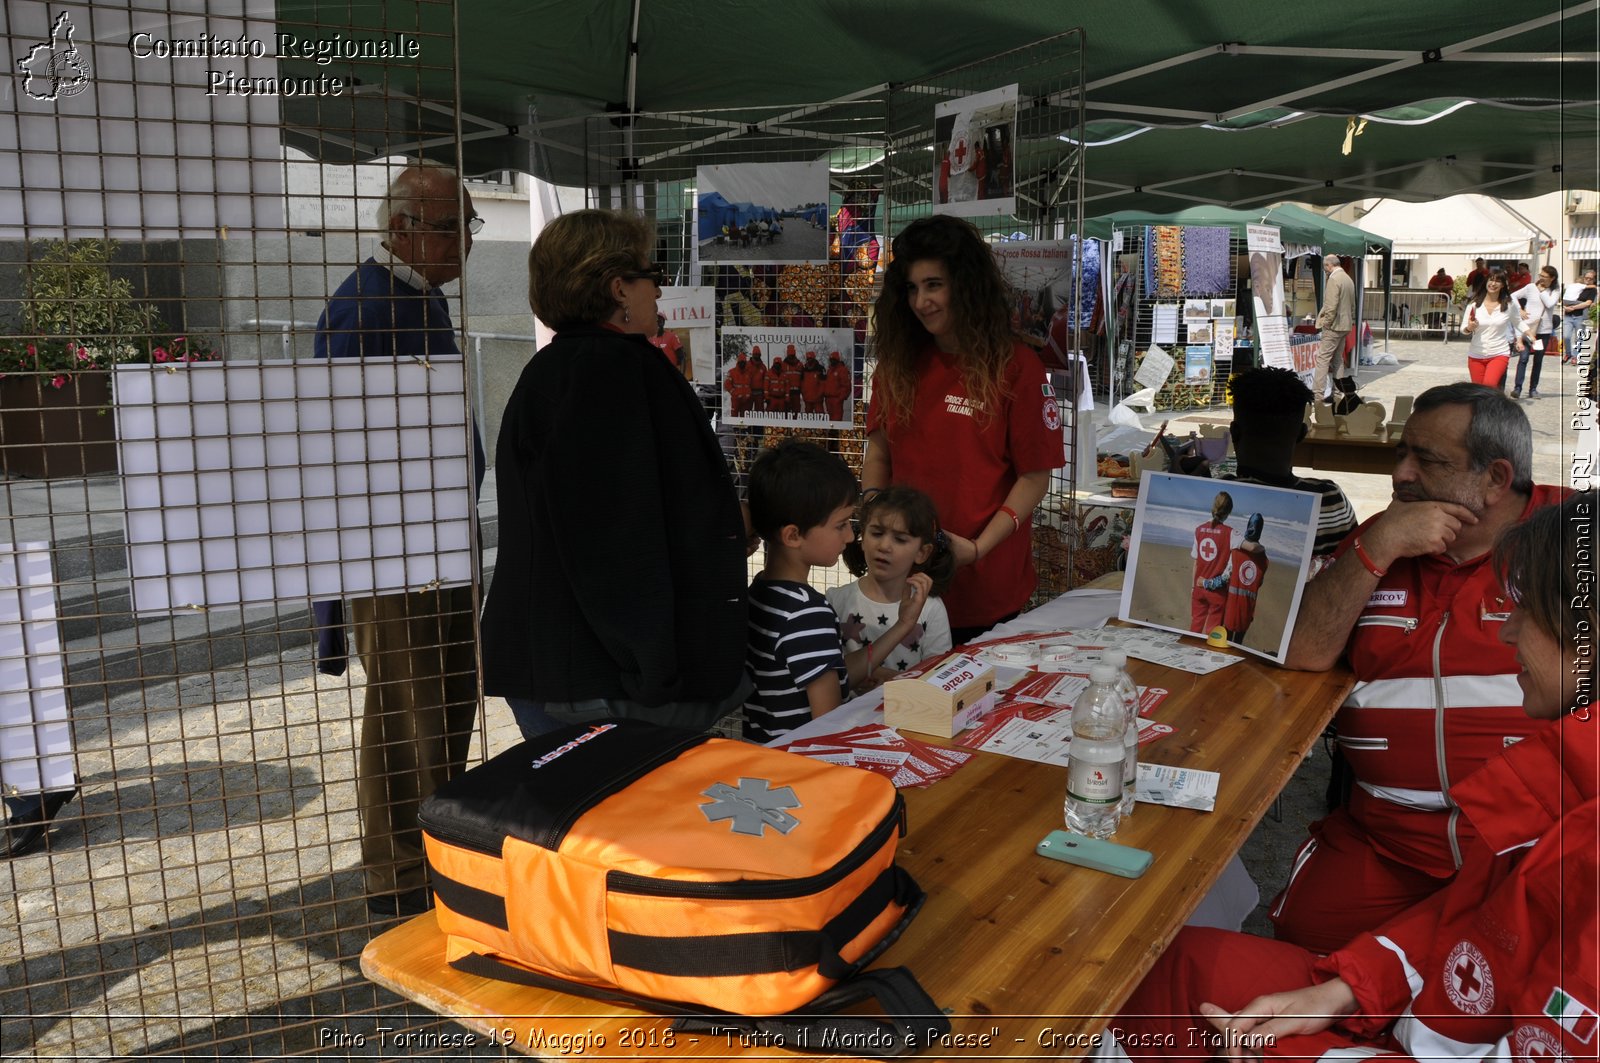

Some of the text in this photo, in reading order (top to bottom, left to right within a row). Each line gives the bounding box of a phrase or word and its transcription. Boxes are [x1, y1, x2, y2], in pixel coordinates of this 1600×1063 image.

[1002, 247, 1068, 259] Croce Rossa Italiana
[672, 306, 711, 320] ITAL
[944, 394, 964, 405] CROCE
[946, 404, 974, 417] ITALIANA
[942, 671, 974, 692] Grazie
